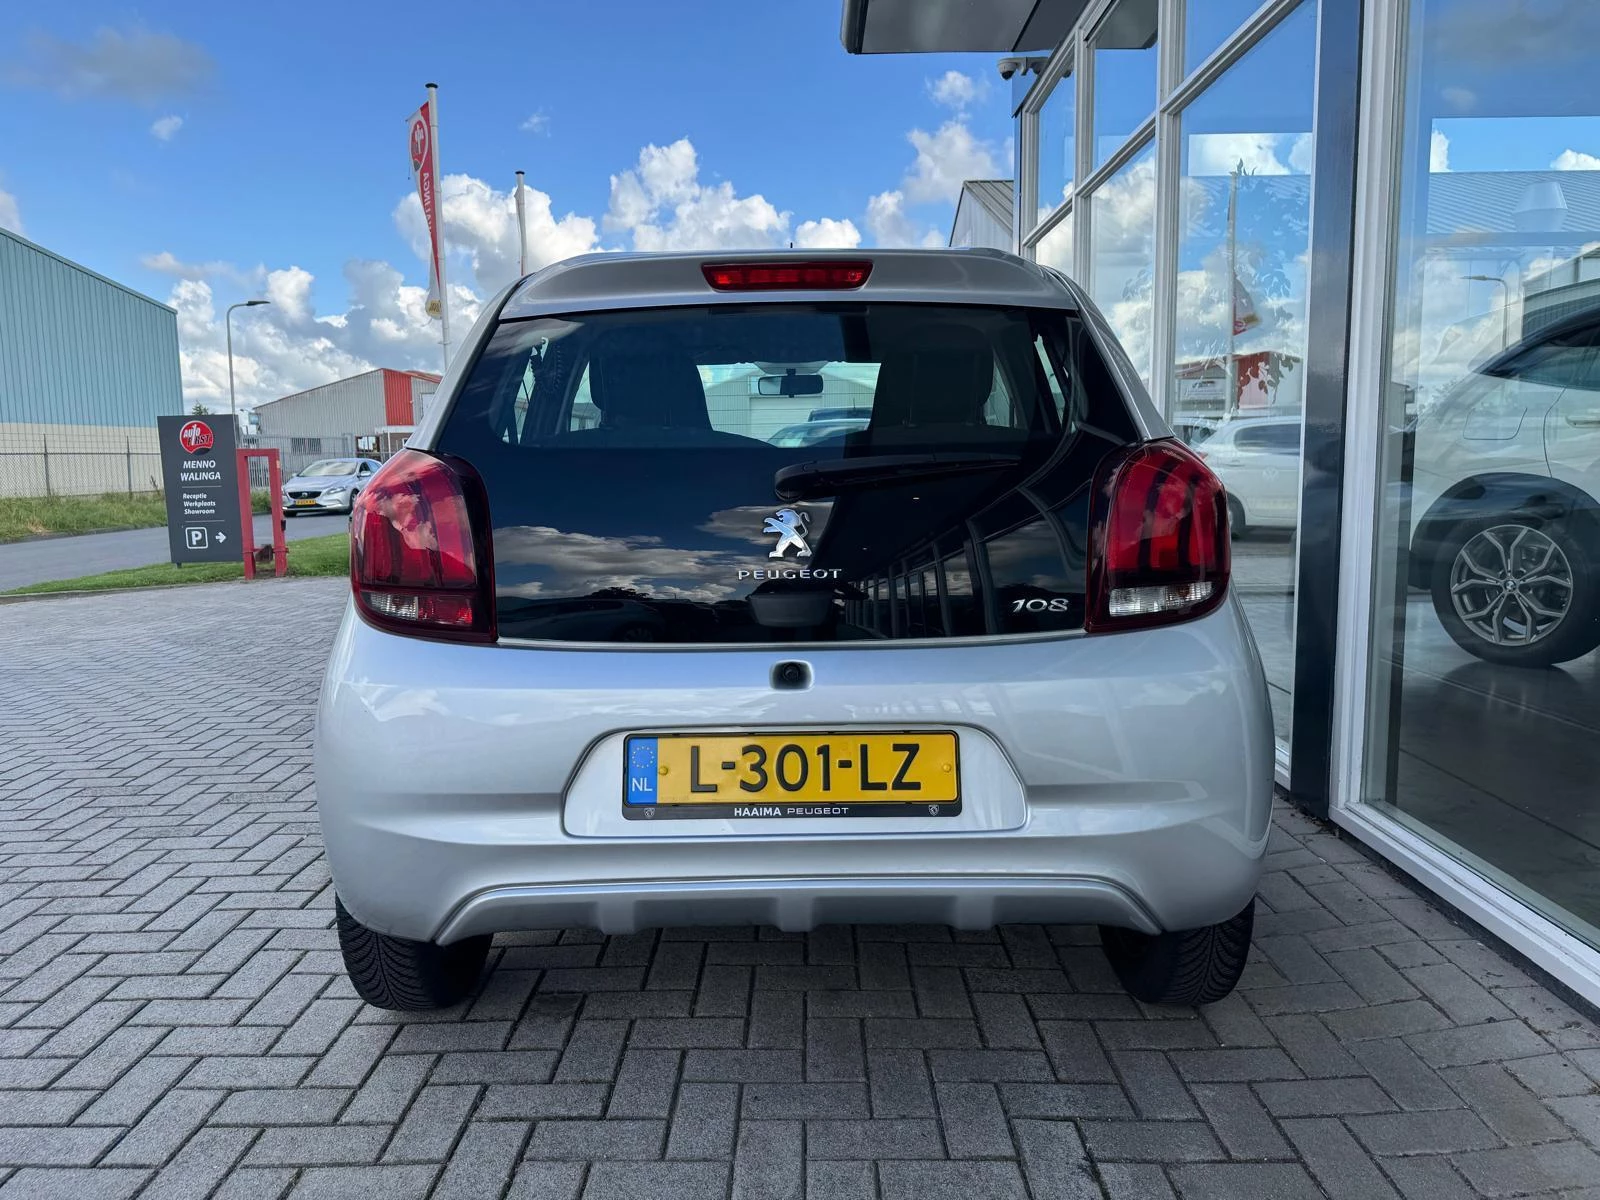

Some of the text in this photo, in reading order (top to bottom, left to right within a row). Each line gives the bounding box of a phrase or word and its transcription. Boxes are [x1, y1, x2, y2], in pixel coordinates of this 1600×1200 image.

[183, 424, 201, 438] AUTO
[183, 460, 216, 469] MENNO
[180, 472, 221, 482] WALINGA
[183, 493, 207, 501] Receptie
[183, 501, 216, 509] Werkplaats
[191, 531, 202, 546] P
[737, 568, 842, 580] PEUGEOT
[1012, 598, 1070, 613] 108
[690, 743, 922, 793] L-301-LZ
[631, 777, 653, 792] NL
[734, 807, 849, 817] HAAIMA PEUGEOT
